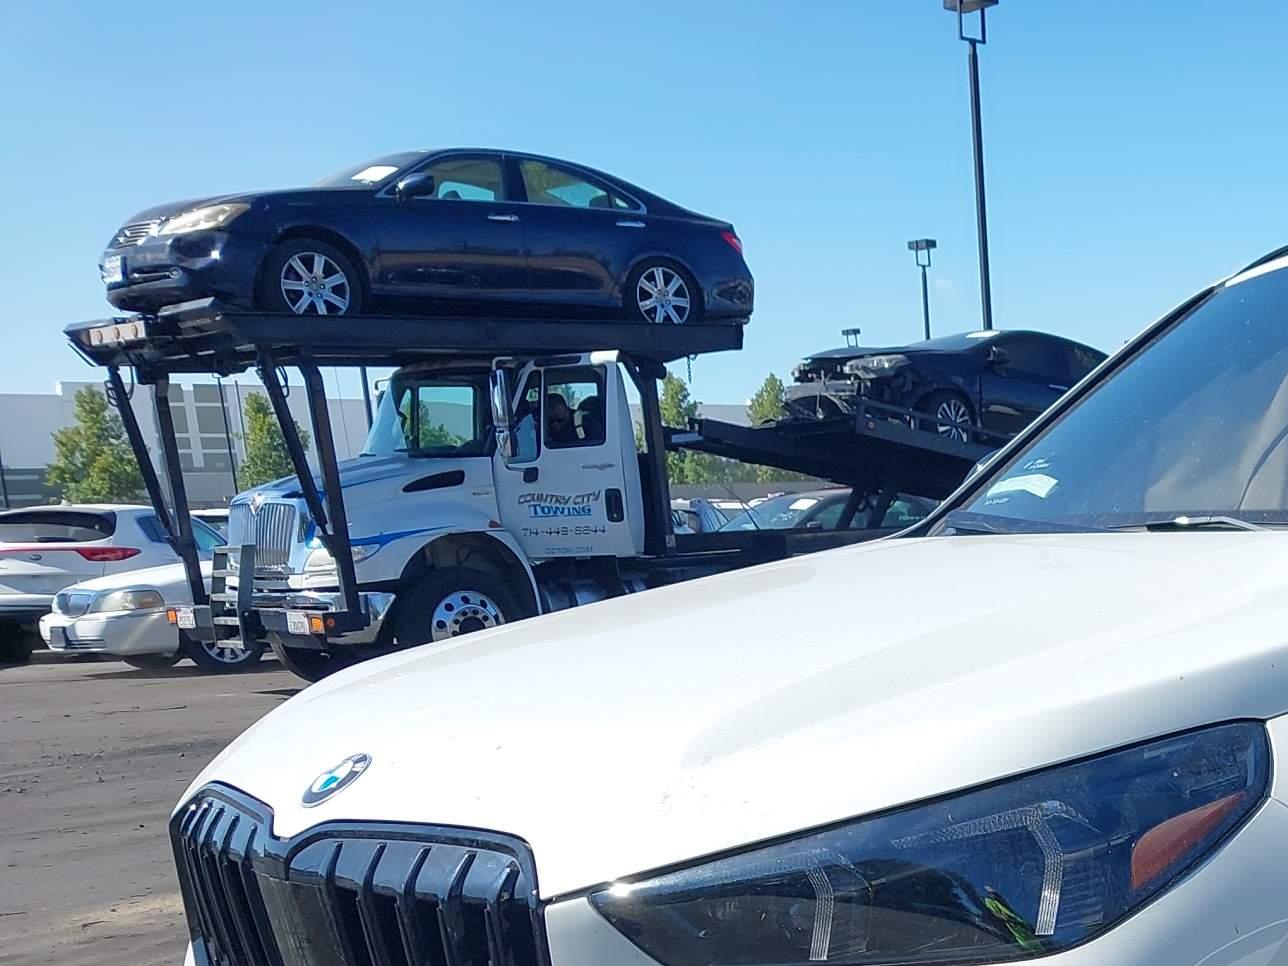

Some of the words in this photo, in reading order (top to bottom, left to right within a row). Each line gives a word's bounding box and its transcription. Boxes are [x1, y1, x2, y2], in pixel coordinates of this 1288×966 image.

[518, 492, 572, 506] COUNTRY
[572, 490, 602, 506] CITY
[528, 503, 593, 517] TOWING
